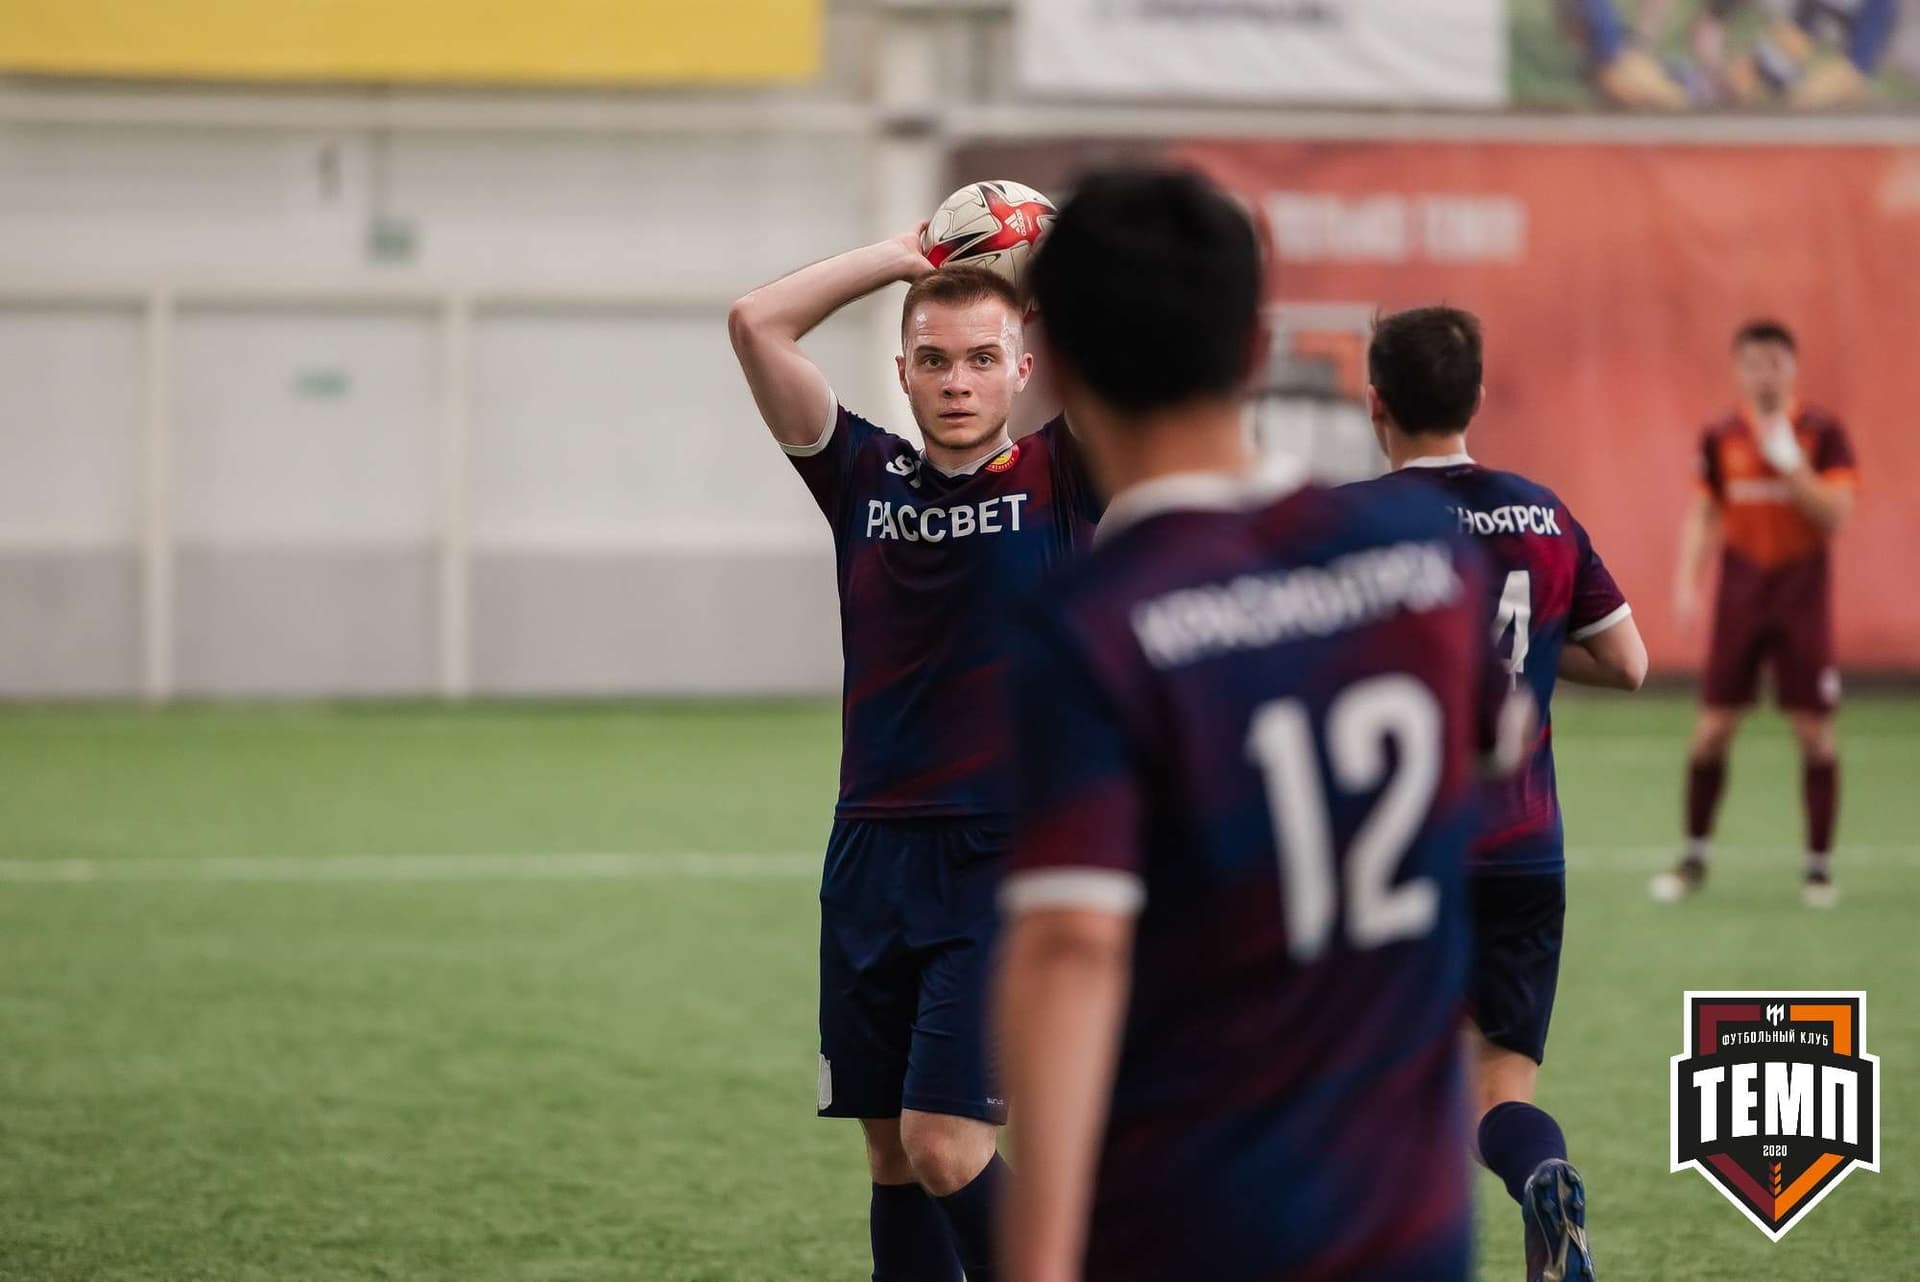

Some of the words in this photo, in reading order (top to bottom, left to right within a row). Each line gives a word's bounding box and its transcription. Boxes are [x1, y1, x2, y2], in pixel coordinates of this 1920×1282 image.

[866, 493, 1028, 543] РАССВЕТ
[1446, 504, 1562, 536] НОЯРСК
[1246, 673, 1443, 960] 12
